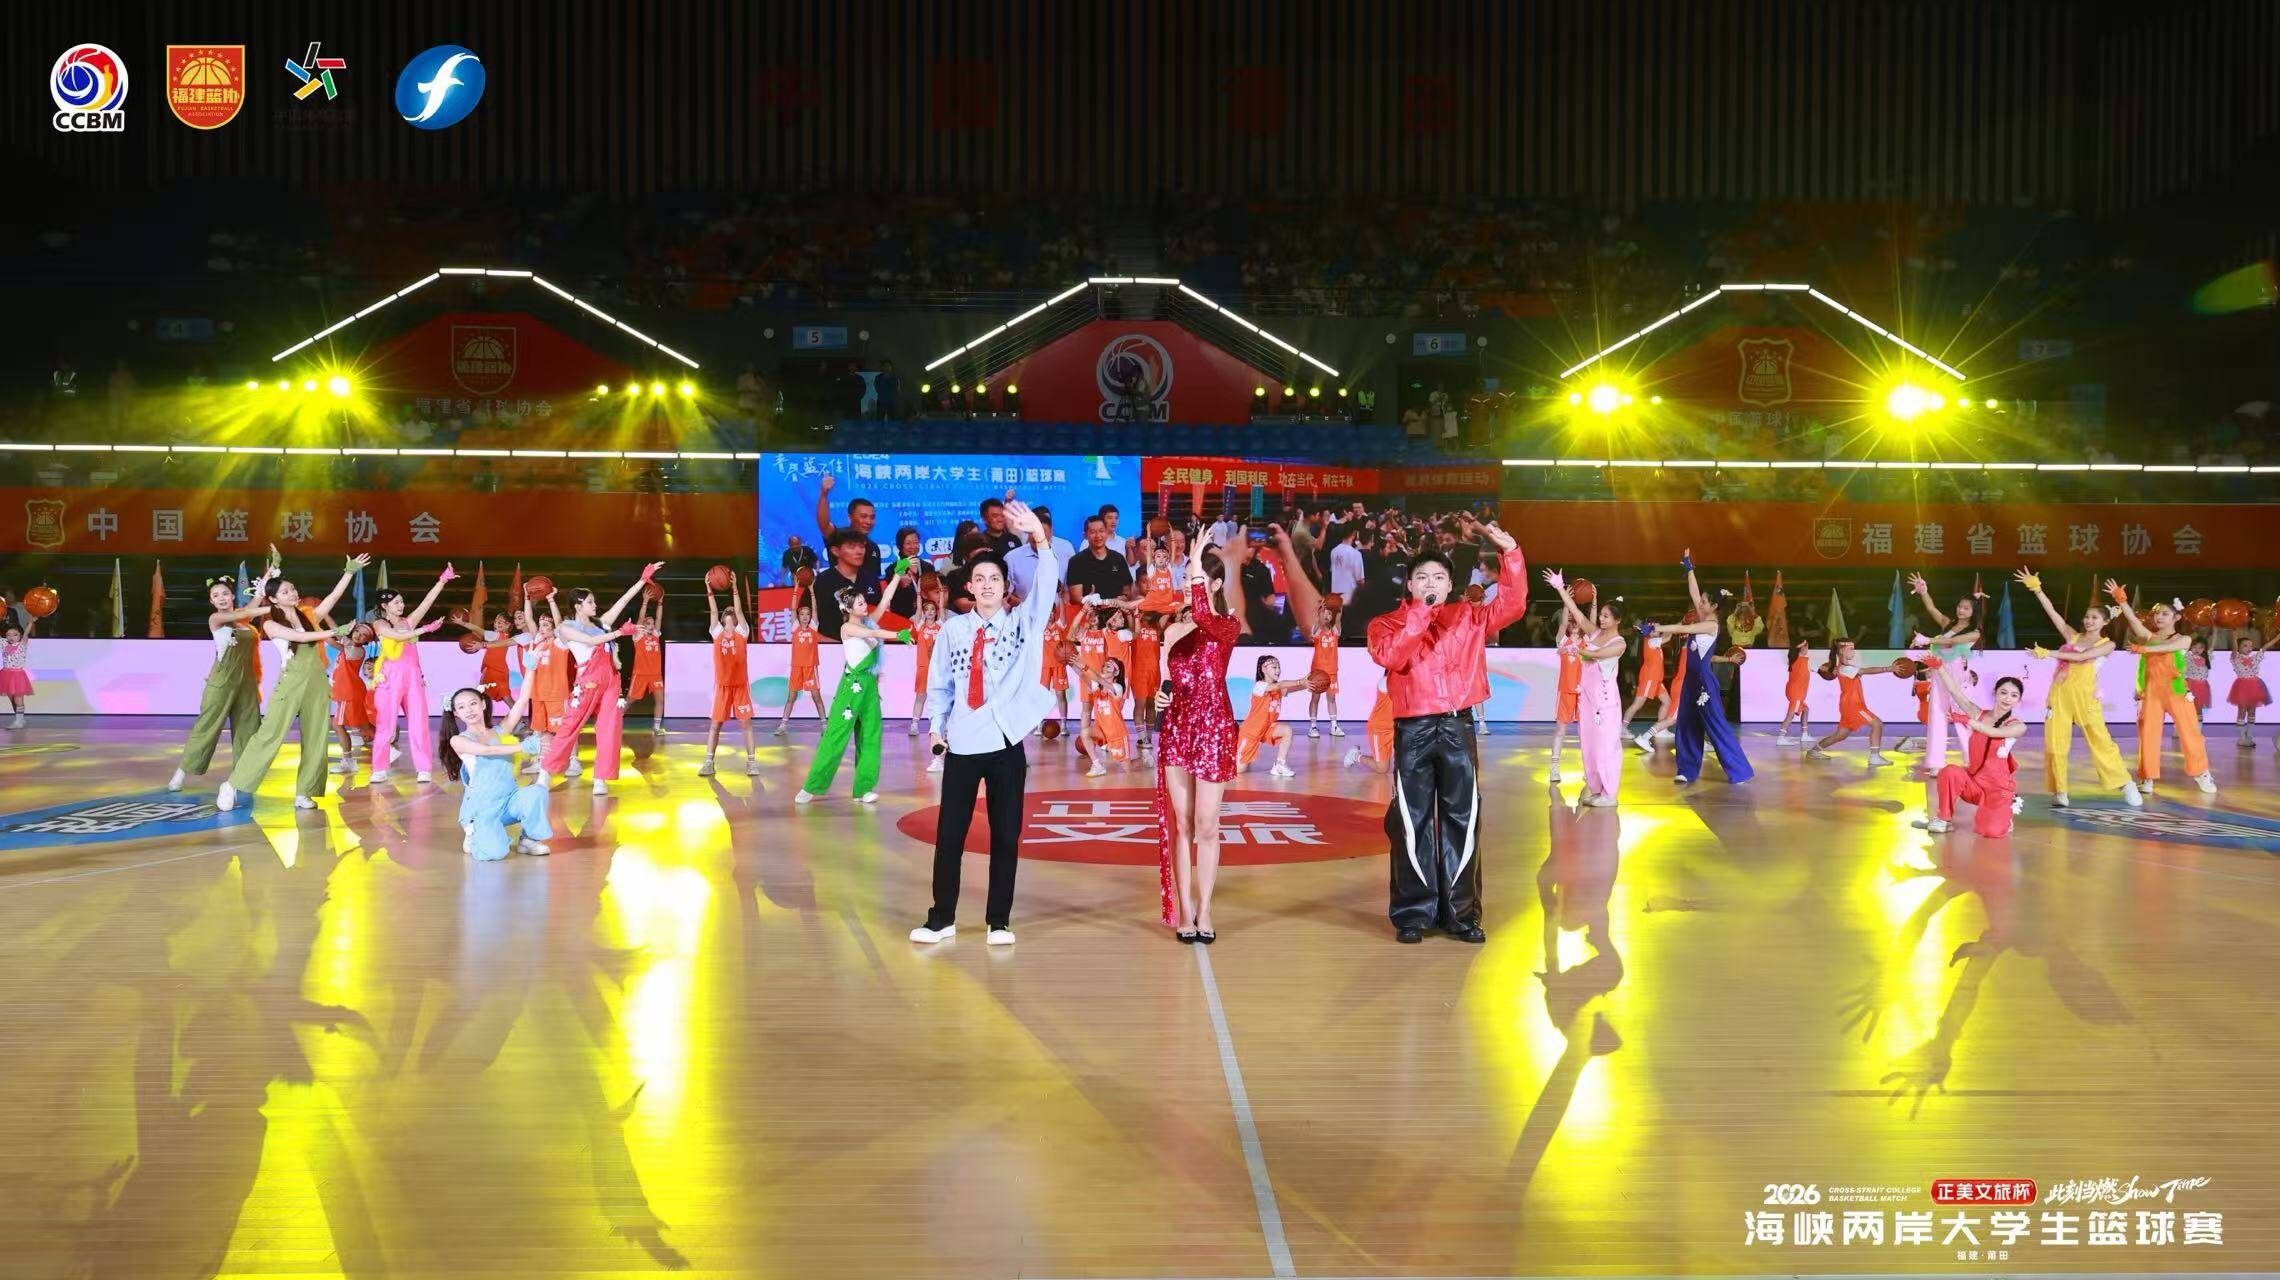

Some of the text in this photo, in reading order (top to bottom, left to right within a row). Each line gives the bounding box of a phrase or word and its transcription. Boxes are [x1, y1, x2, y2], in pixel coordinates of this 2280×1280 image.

[811, 331, 819, 343] 5
[1430, 338, 1439, 350] 6
[87, 509, 442, 543] 中国篮球协会
[1861, 522, 2204, 556] 福建省篮球协会
